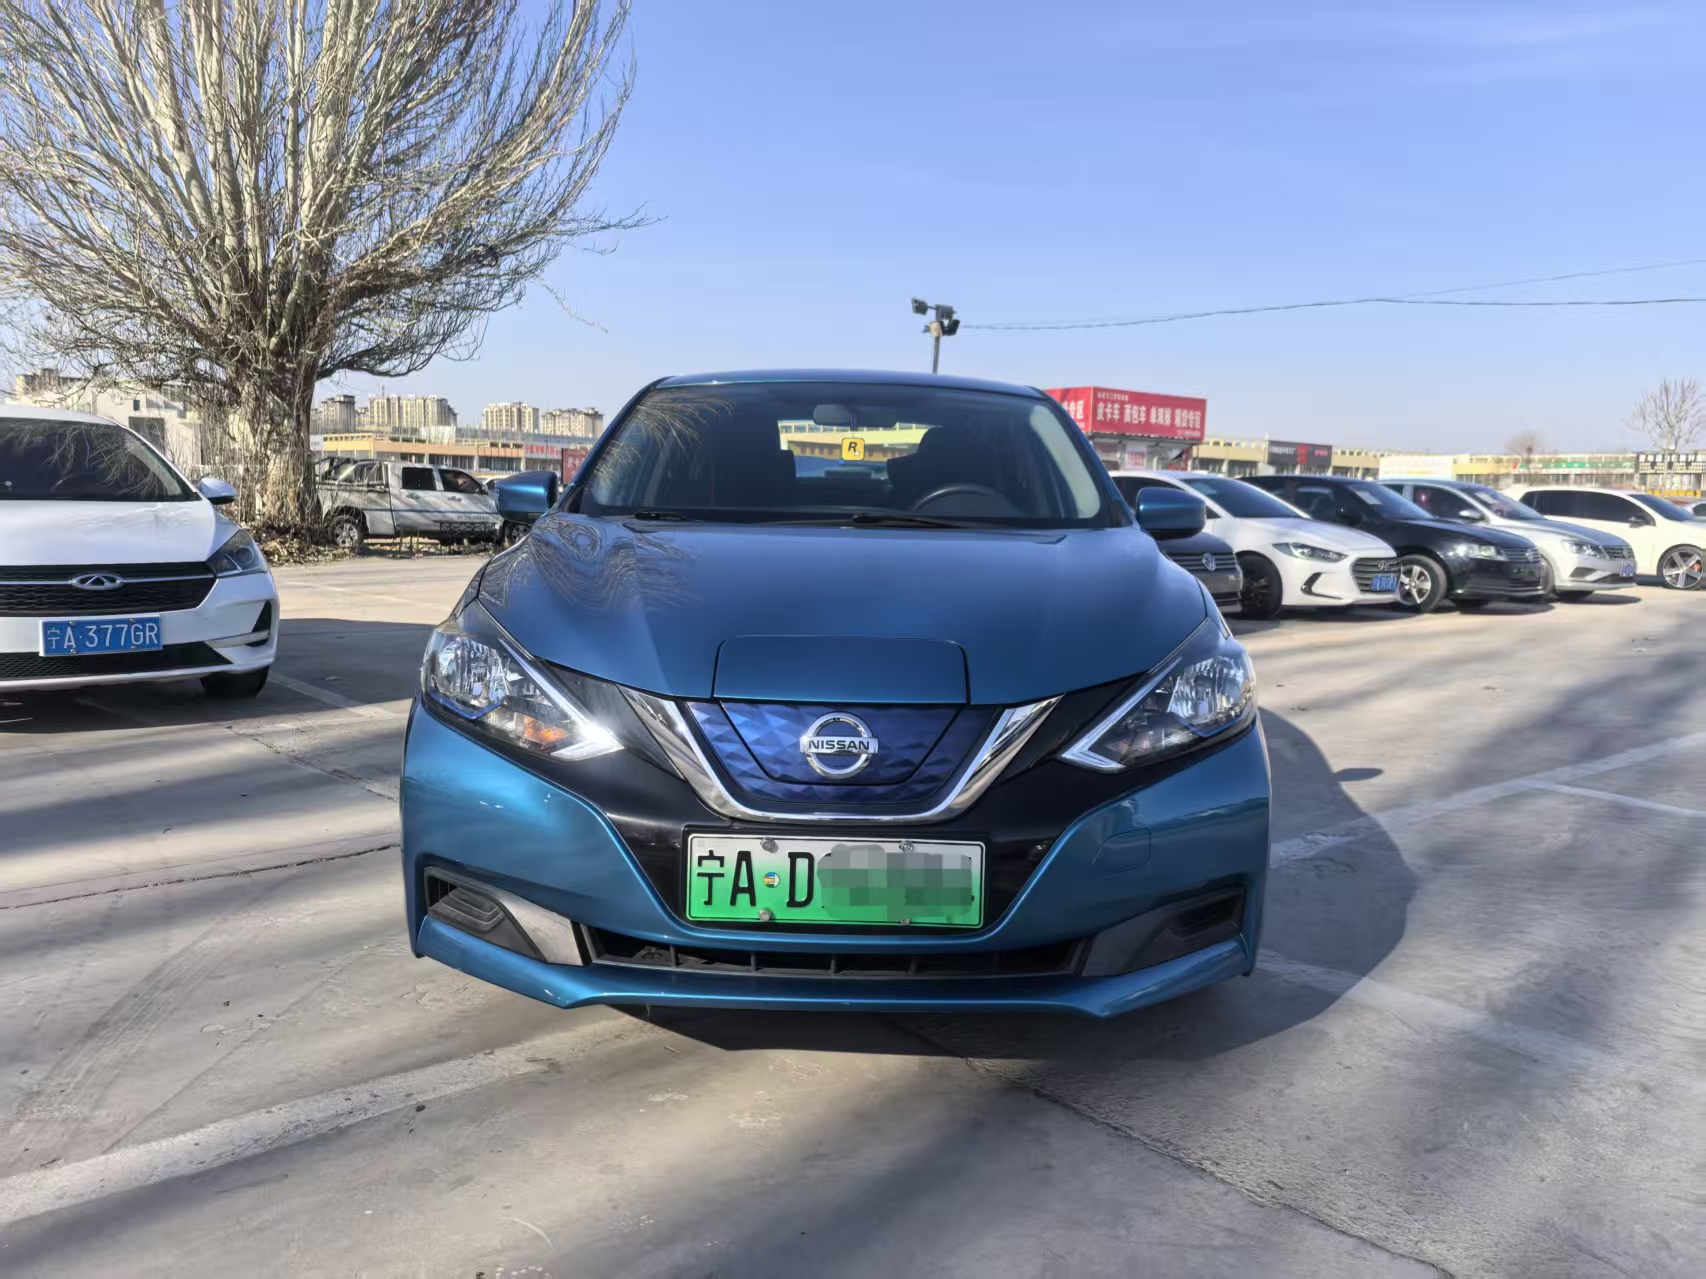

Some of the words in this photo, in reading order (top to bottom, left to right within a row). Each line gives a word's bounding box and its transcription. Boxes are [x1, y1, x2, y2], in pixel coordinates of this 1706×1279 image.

[1096, 401, 1120, 422] 皮卡车
[1124, 404, 1146, 424] 面包车
[808, 739, 870, 751] NISSAN
